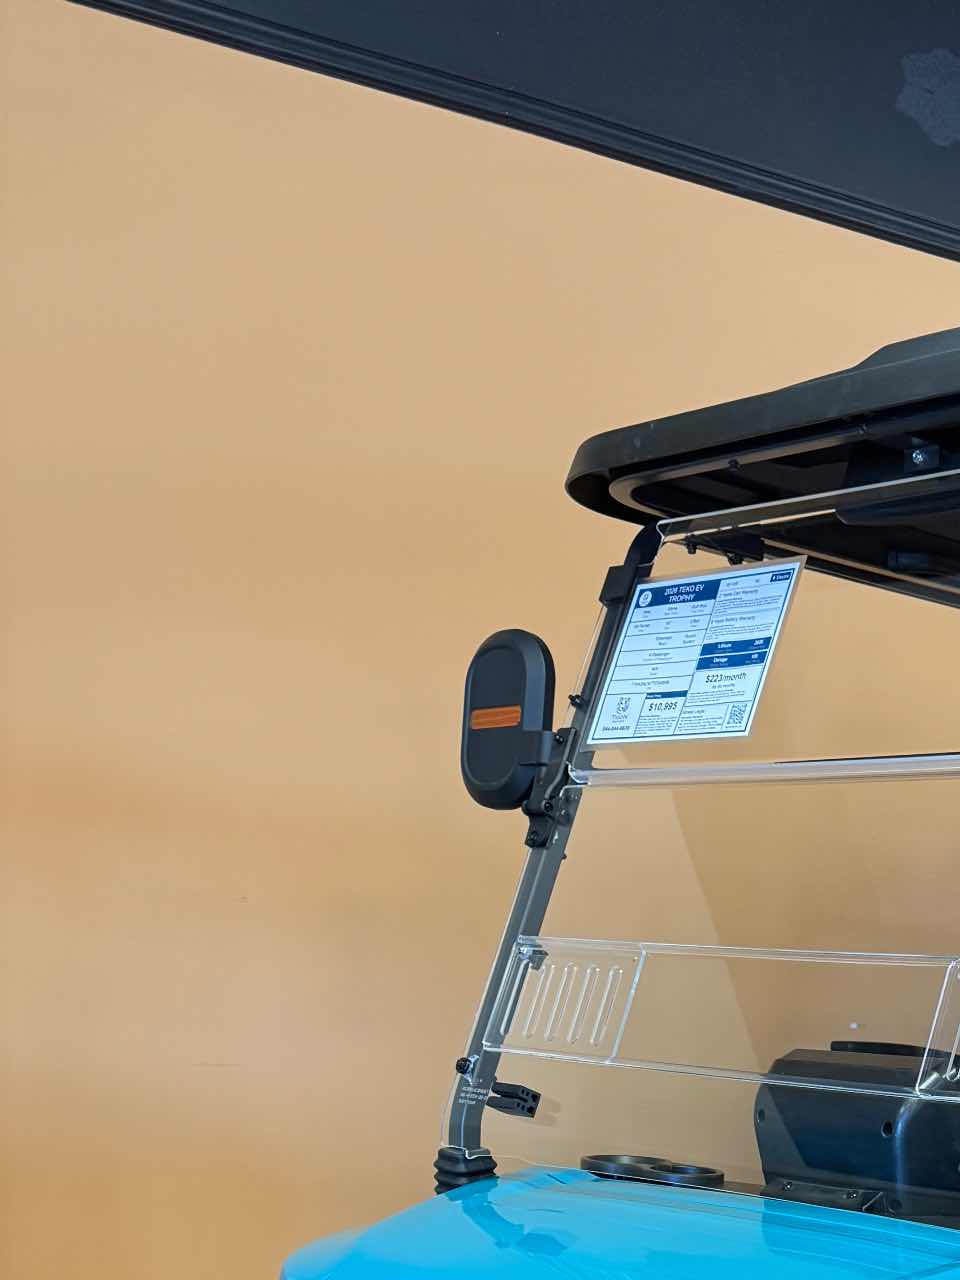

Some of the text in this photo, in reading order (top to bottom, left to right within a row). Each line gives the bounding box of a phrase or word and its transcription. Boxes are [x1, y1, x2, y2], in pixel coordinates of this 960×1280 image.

[678, 585, 695, 594] TEKO
[695, 584, 705, 592] EV
[668, 593, 696, 603] TROPHY
[705, 672, 747, 684] $223/month
[648, 701, 678, 712] $10,995
